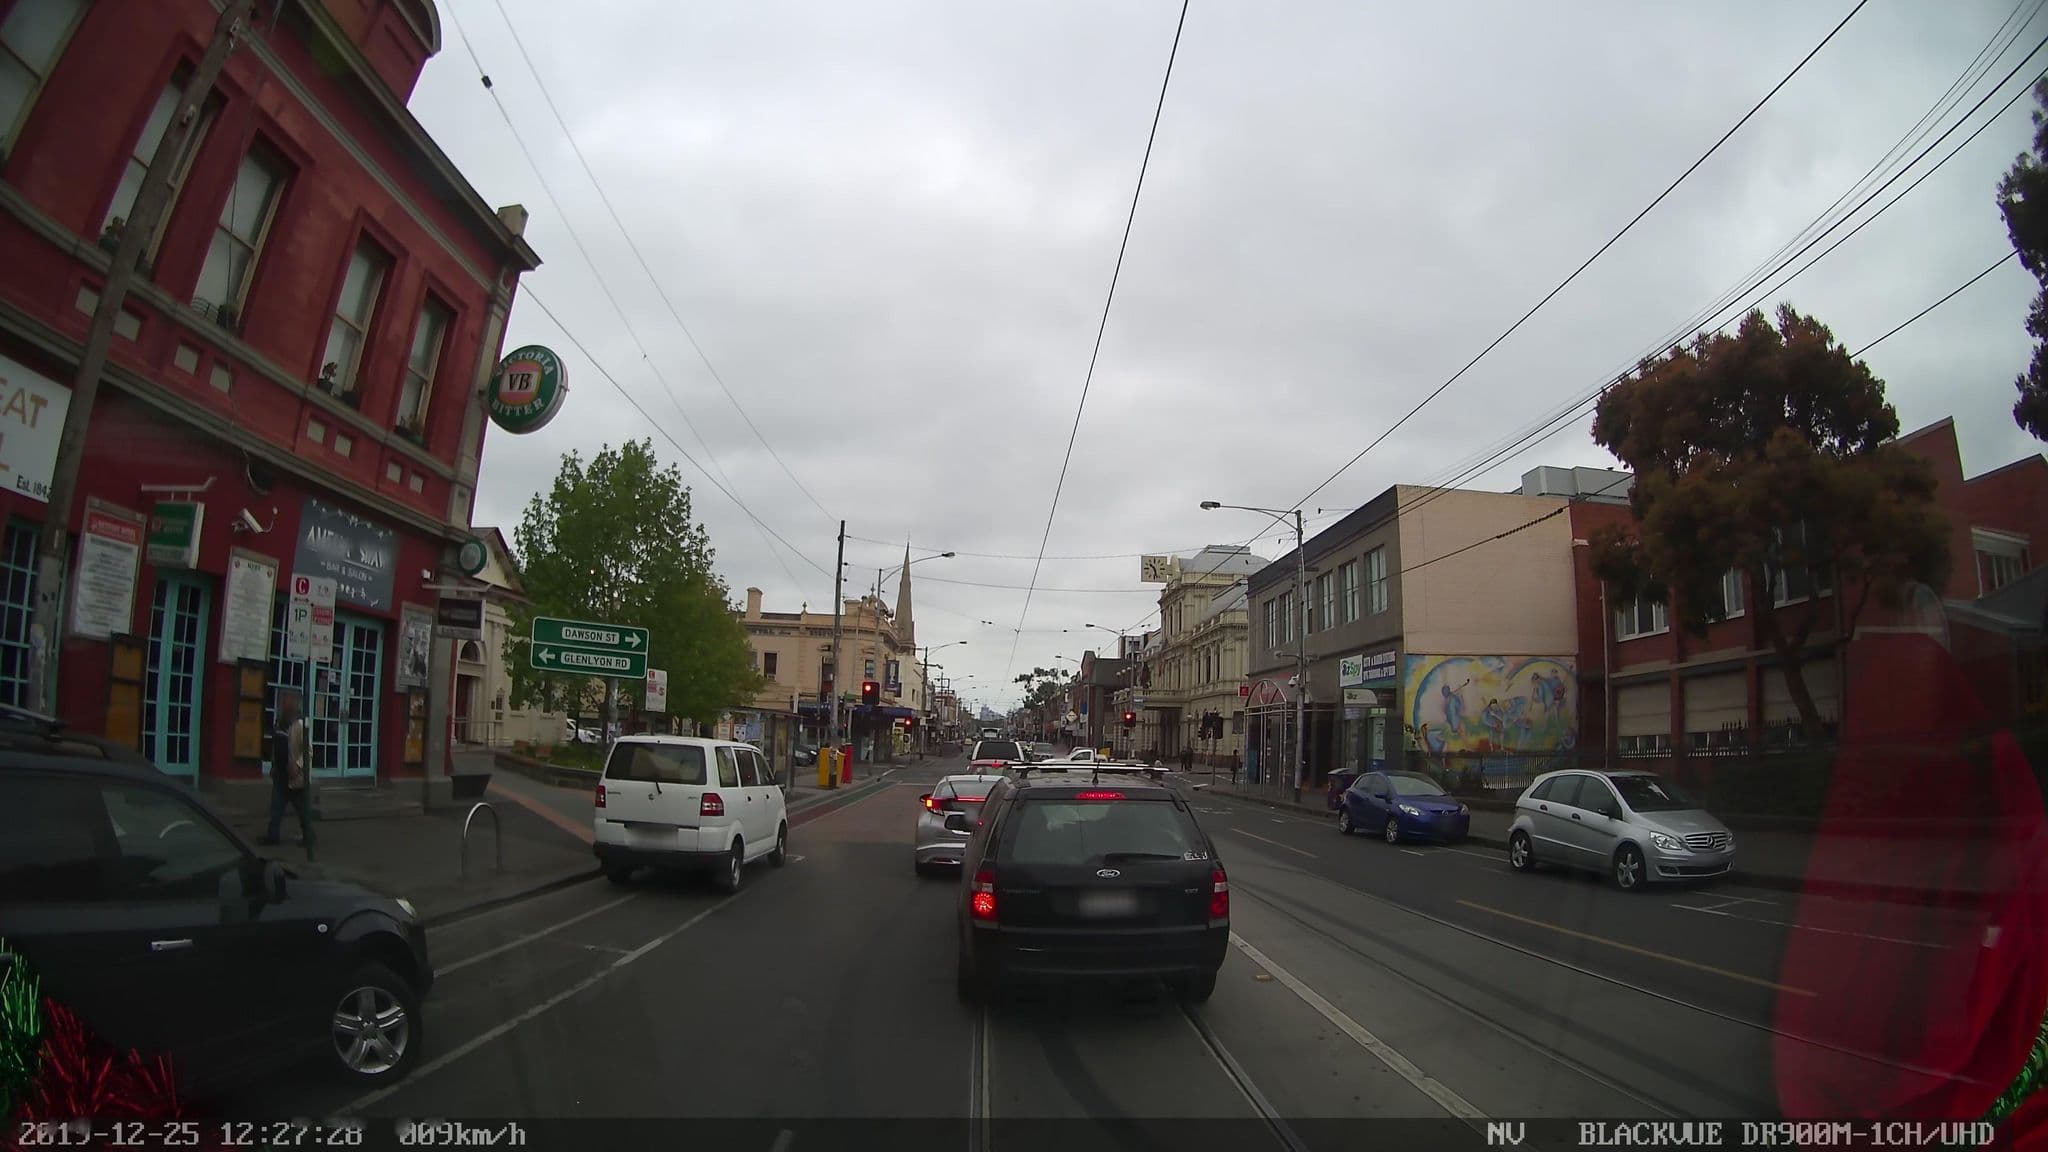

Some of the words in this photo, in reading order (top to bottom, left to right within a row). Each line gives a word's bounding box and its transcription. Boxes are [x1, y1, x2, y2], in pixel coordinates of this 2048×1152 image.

[496, 352, 554, 376] VICTORIA
[509, 374, 532, 391] VB
[491, 398, 543, 417] BITTER
[295, 608, 307, 622] 1P
[565, 629, 603, 642] DAWSON
[606, 634, 617, 643] ST
[564, 653, 613, 667] GLENLYON
[615, 659, 628, 669] RD
